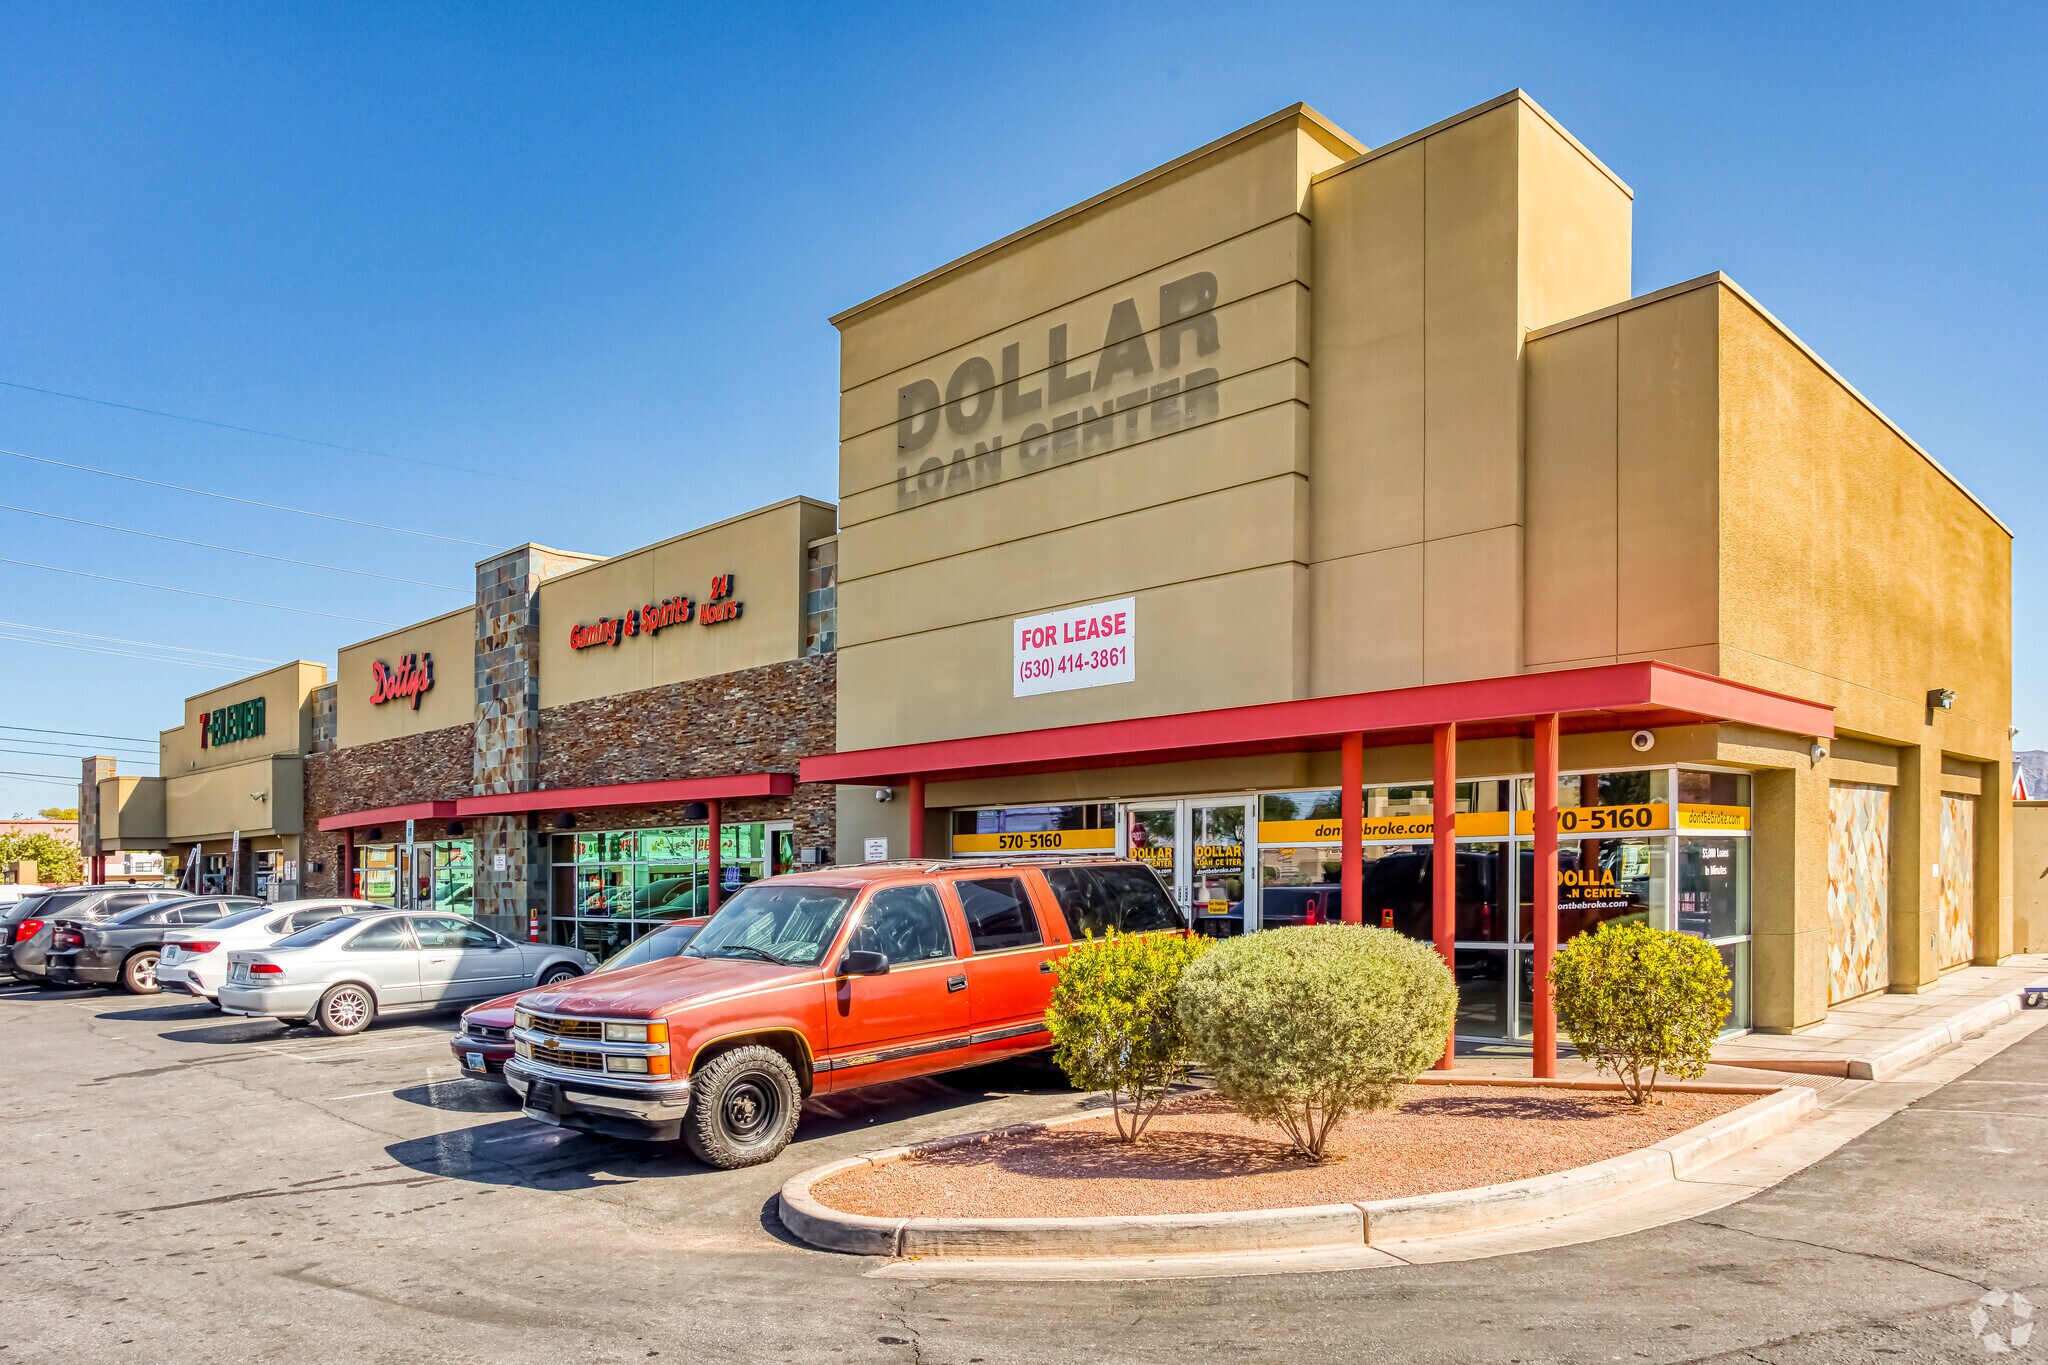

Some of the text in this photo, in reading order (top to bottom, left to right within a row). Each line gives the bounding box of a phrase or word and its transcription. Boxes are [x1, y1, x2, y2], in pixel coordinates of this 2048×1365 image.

[898, 271, 1220, 456] DOLLAR
[897, 367, 1219, 508] LOAN CENTER
[710, 574, 734, 600] 24
[569, 596, 695, 650] Gaming & Spirits
[699, 600, 743, 626] Hours
[1021, 612, 1127, 651] FOR LEASE
[1020, 646, 1126, 682] (530) 414-3861
[370, 651, 434, 711] Dotty's
[1533, 807, 1653, 831] 0-5160
[1689, 809, 1741, 825] dontbebroke.com
[999, 833, 1062, 849] 570-5160
[1130, 848, 1173, 859] DOLLAR
[1195, 845, 1242, 857] DOLLAR
[1195, 858, 1213, 866] LOAN
[1558, 900, 1628, 910] ontbebroke.com
[1584, 888, 1629, 898] CENTE
